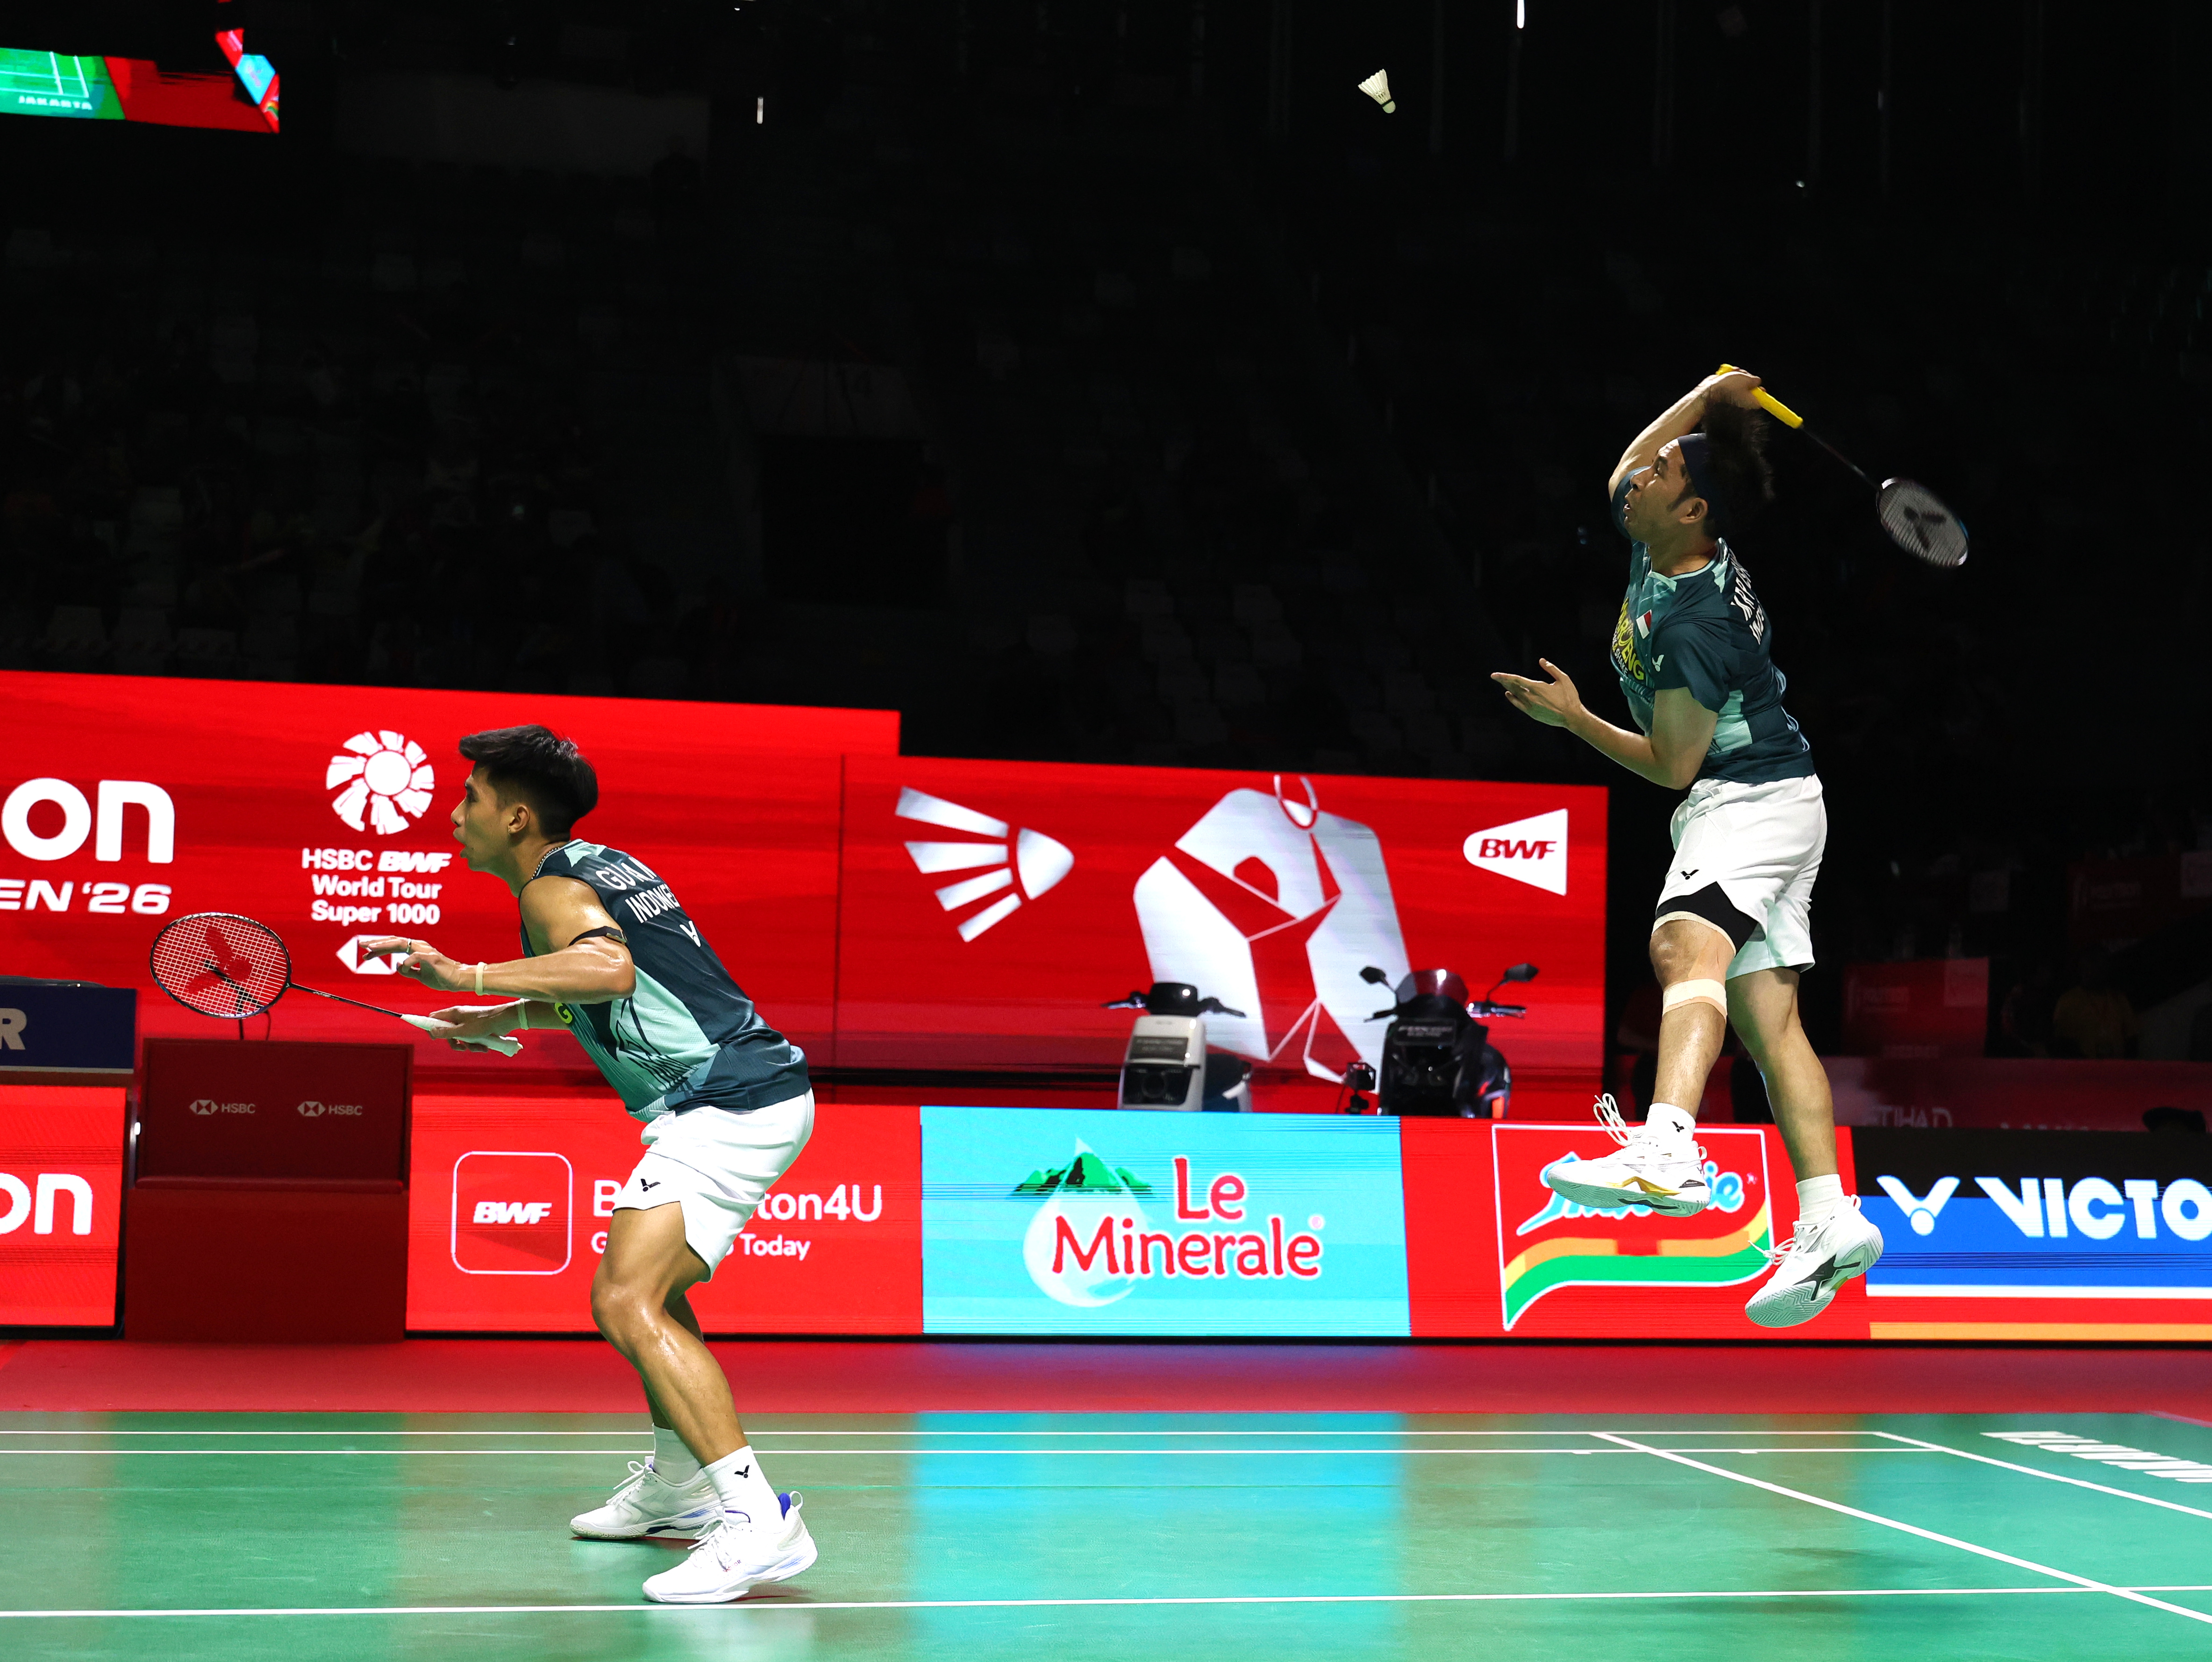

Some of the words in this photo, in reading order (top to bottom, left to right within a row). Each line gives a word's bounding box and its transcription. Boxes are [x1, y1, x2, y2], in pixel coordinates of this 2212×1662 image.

[2, 778, 175, 864] on
[302, 848, 374, 871] HSBC
[378, 851, 453, 873] BWF
[1479, 839, 1557, 860] BWF
[311, 874, 385, 898] World
[387, 876, 443, 899] Tour
[311, 899, 382, 927] Super
[386, 903, 441, 925] 1000
[221, 1103, 256, 1114] HSBC
[329, 1106, 363, 1116] HSBC
[593, 1179, 883, 1222] Bton4U
[1174, 1157, 1245, 1220] Le
[473, 1201, 553, 1225] BWF
[1975, 1176, 2212, 1241] VICTO
[738, 1233, 811, 1261] Today
[1052, 1215, 1320, 1277] Minerale
